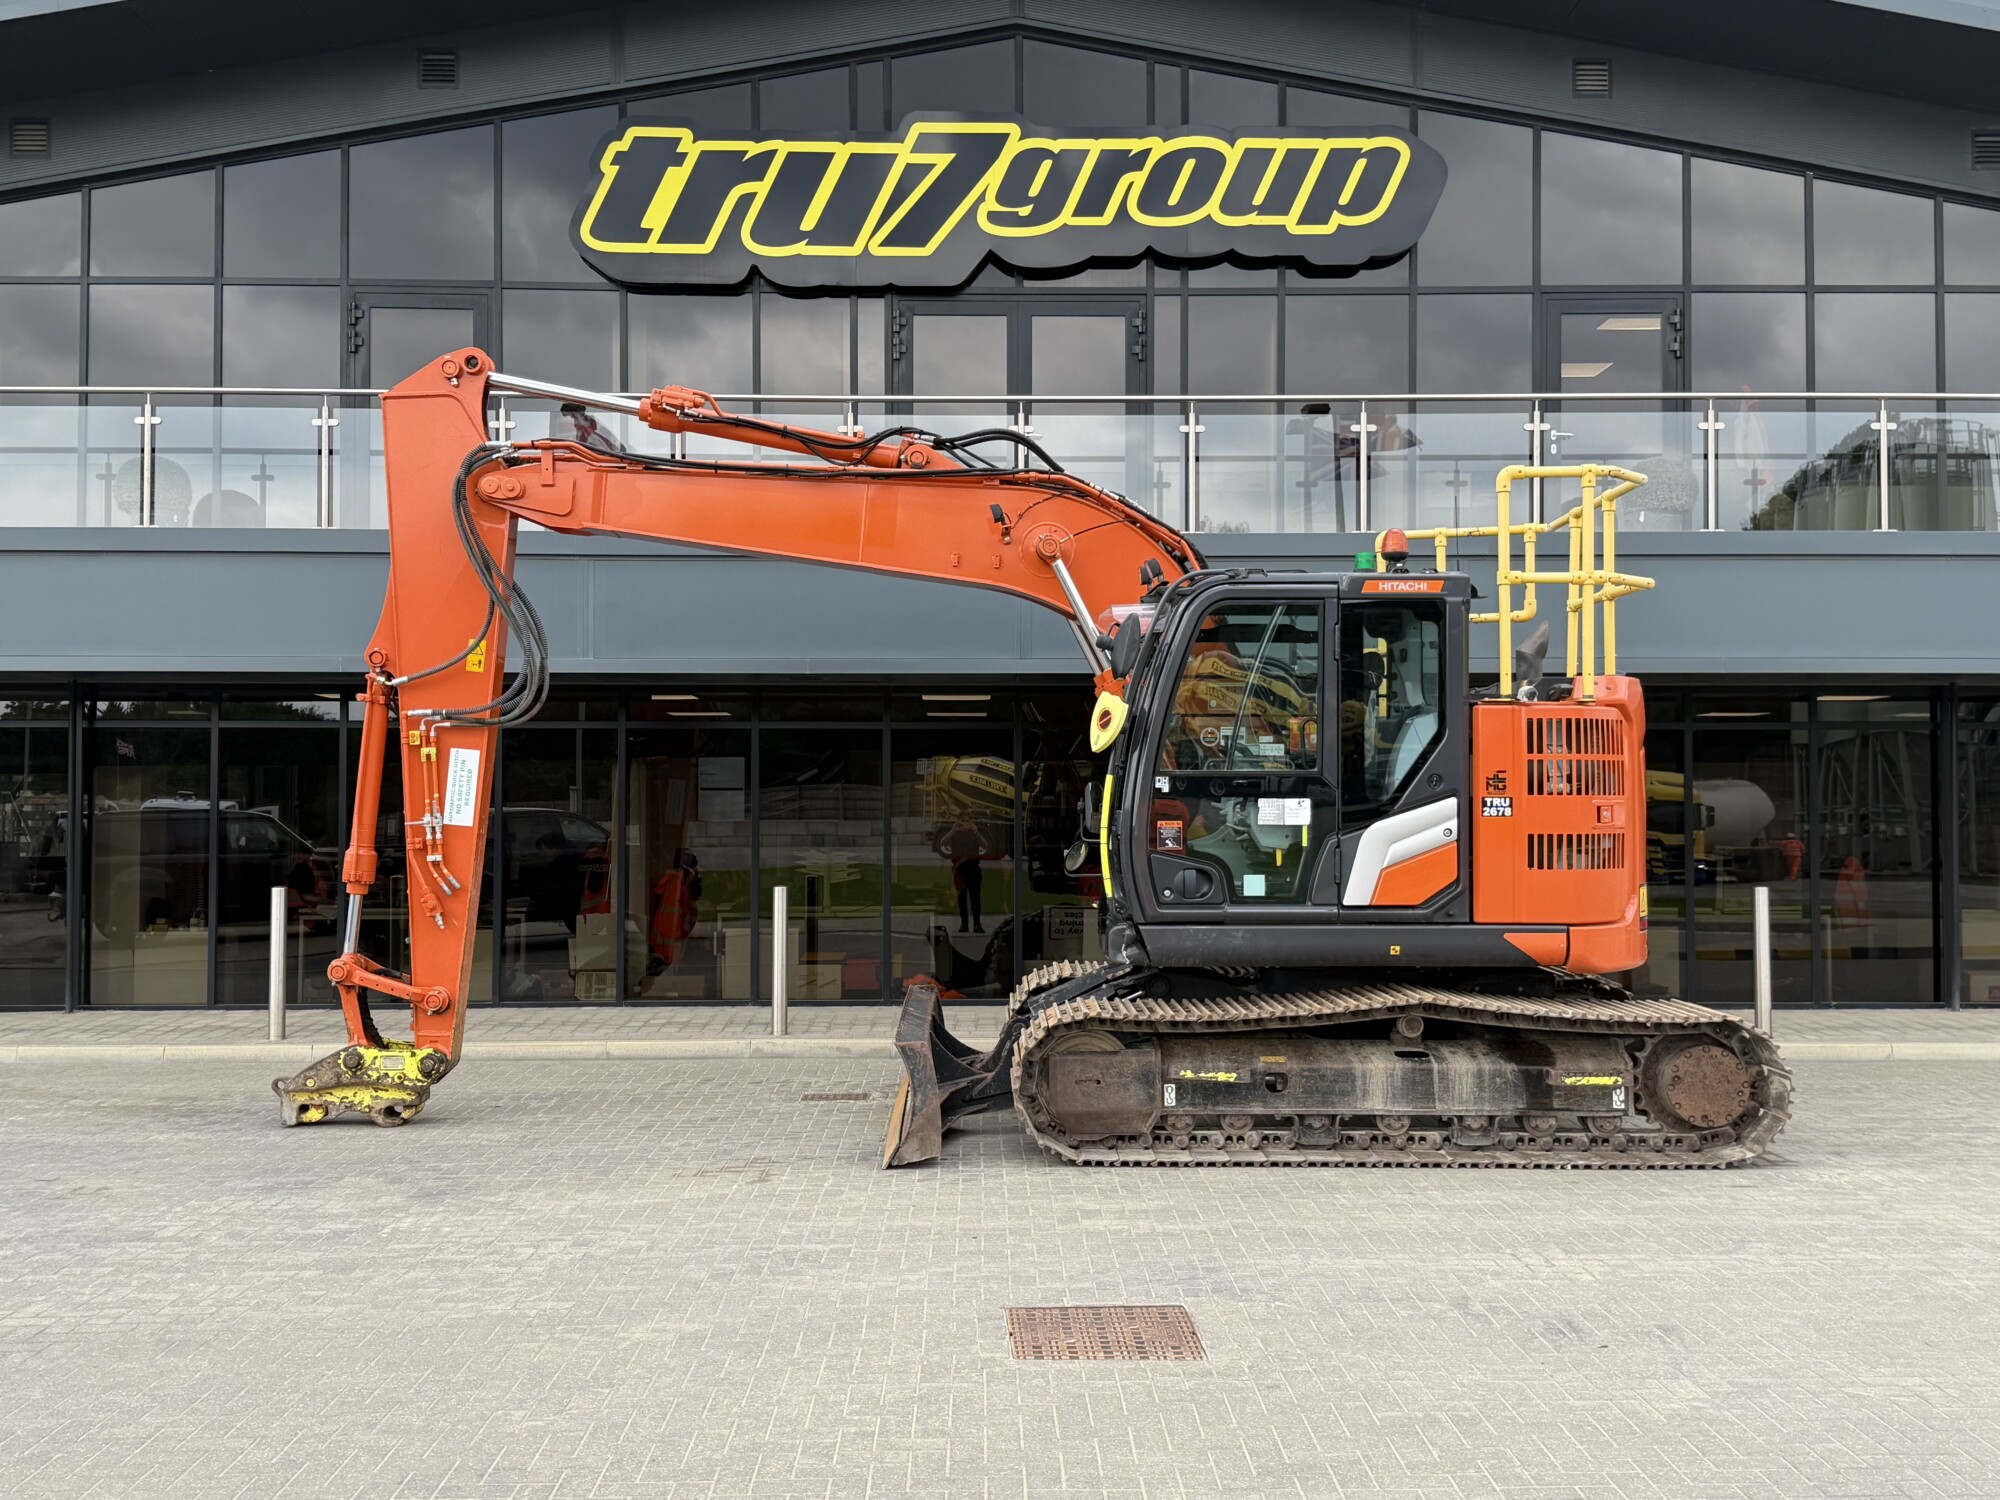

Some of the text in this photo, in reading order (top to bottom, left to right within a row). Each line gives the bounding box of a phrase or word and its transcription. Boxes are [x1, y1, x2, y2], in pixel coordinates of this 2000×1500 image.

[1378, 581, 1428, 591] HITACHI
[457, 773, 465, 802] SAFETY
[463, 768, 473, 807] REQUIRED
[448, 788, 456, 823] AUTOMATIC
[1483, 797, 1510, 807] TRU
[455, 803, 462, 815] NO
[1482, 807, 1512, 817] 2678
